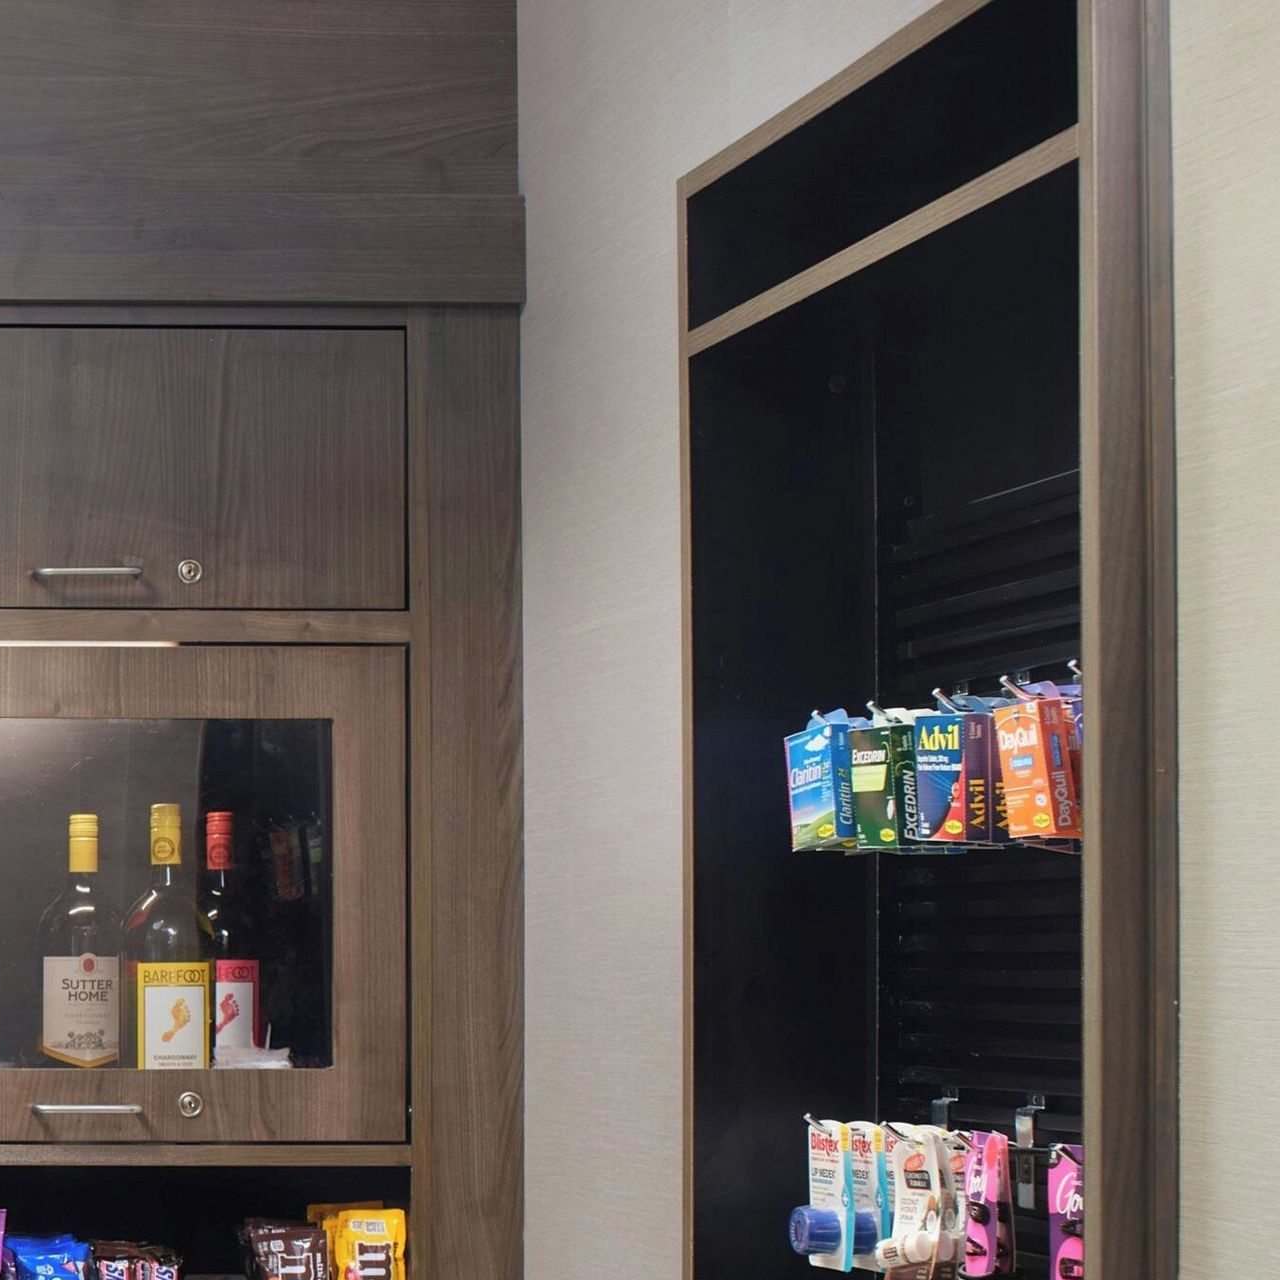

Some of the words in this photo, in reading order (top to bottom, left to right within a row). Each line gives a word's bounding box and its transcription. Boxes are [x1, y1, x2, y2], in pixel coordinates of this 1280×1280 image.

[917, 724, 960, 751] Advil
[998, 723, 1039, 755] DayQuil
[851, 749, 887, 765] EXCEDRIN
[840, 782, 853, 826] Claritin
[903, 769, 918, 840] EXCEDRIN
[969, 777, 986, 831] Advil
[1051, 770, 1073, 827] DayQuil
[61, 978, 113, 990] SUTTER
[143, 968, 206, 984] BAREFOOT
[68, 991, 108, 1002] HOME
[810, 1132, 840, 1157] Blistex
